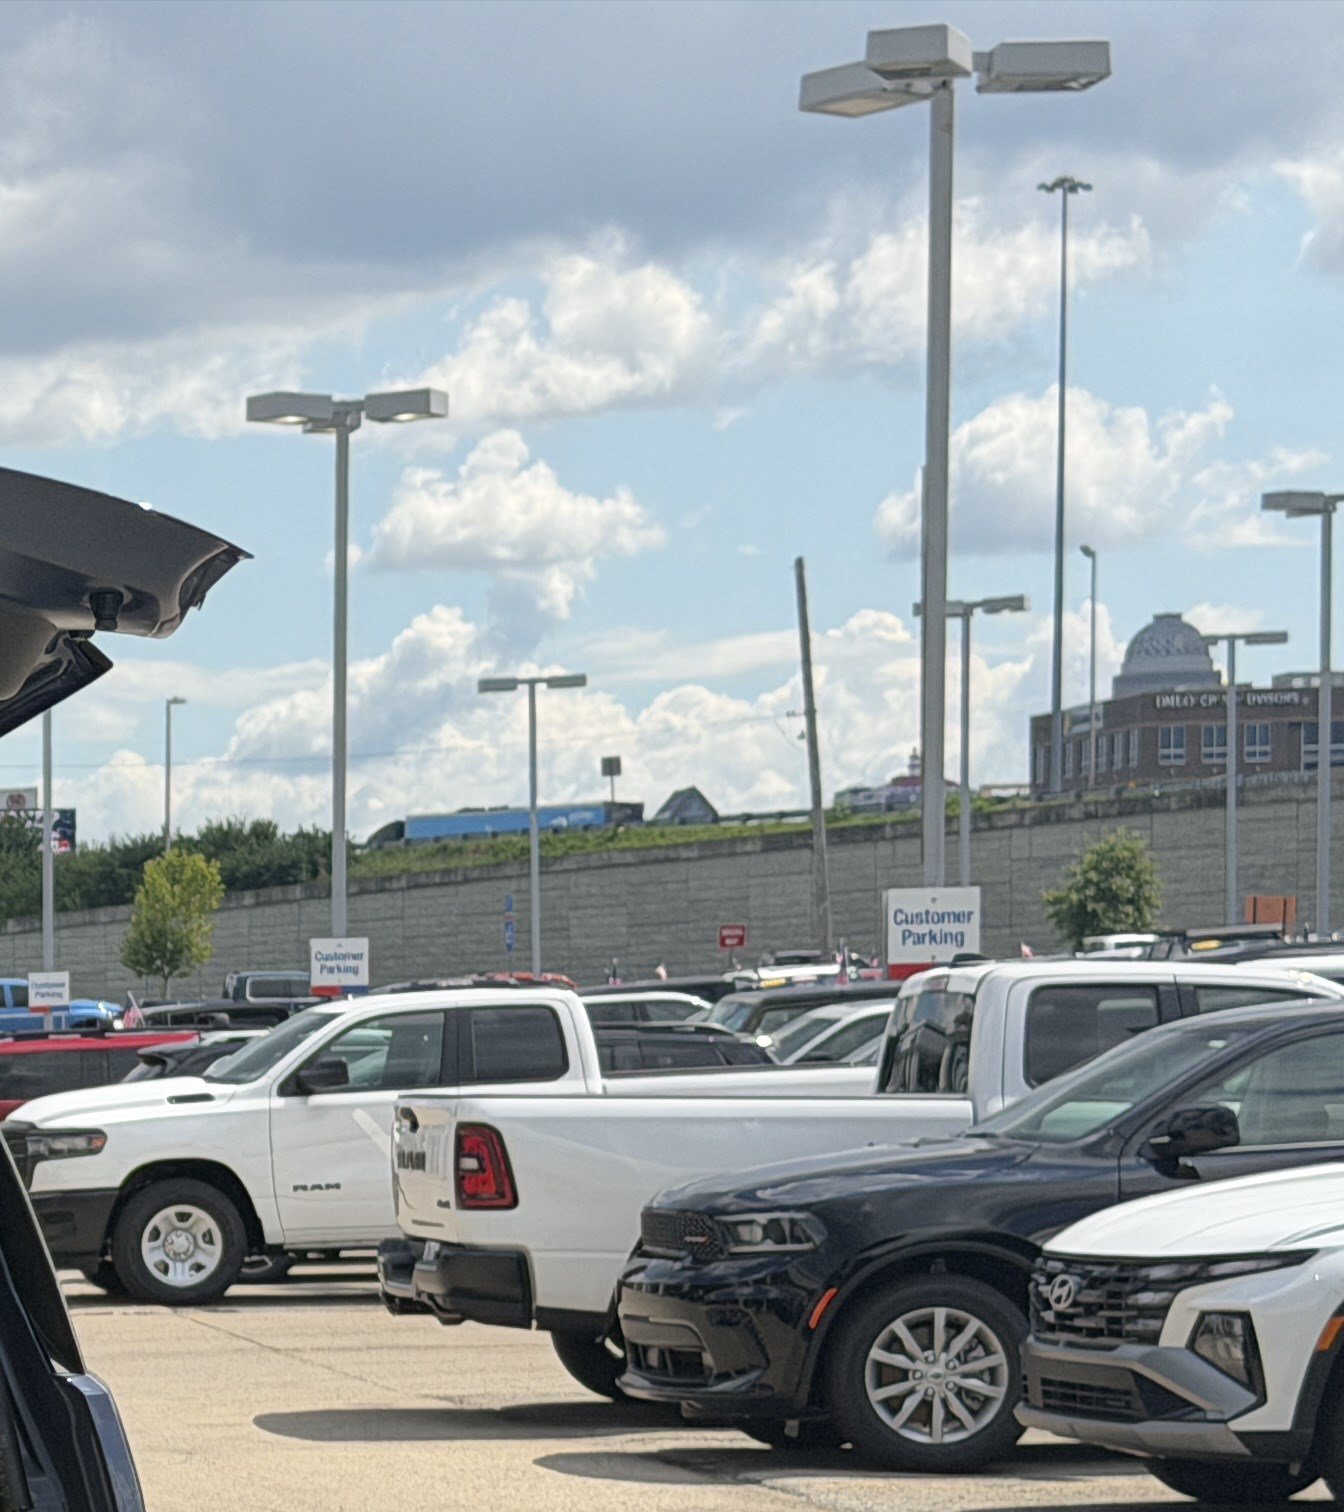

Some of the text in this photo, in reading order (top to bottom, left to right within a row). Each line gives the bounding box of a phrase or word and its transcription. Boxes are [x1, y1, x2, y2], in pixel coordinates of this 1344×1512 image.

[893, 907, 974, 926] Customer
[901, 928, 965, 948] Parking
[292, 1182, 342, 1192] RAM
